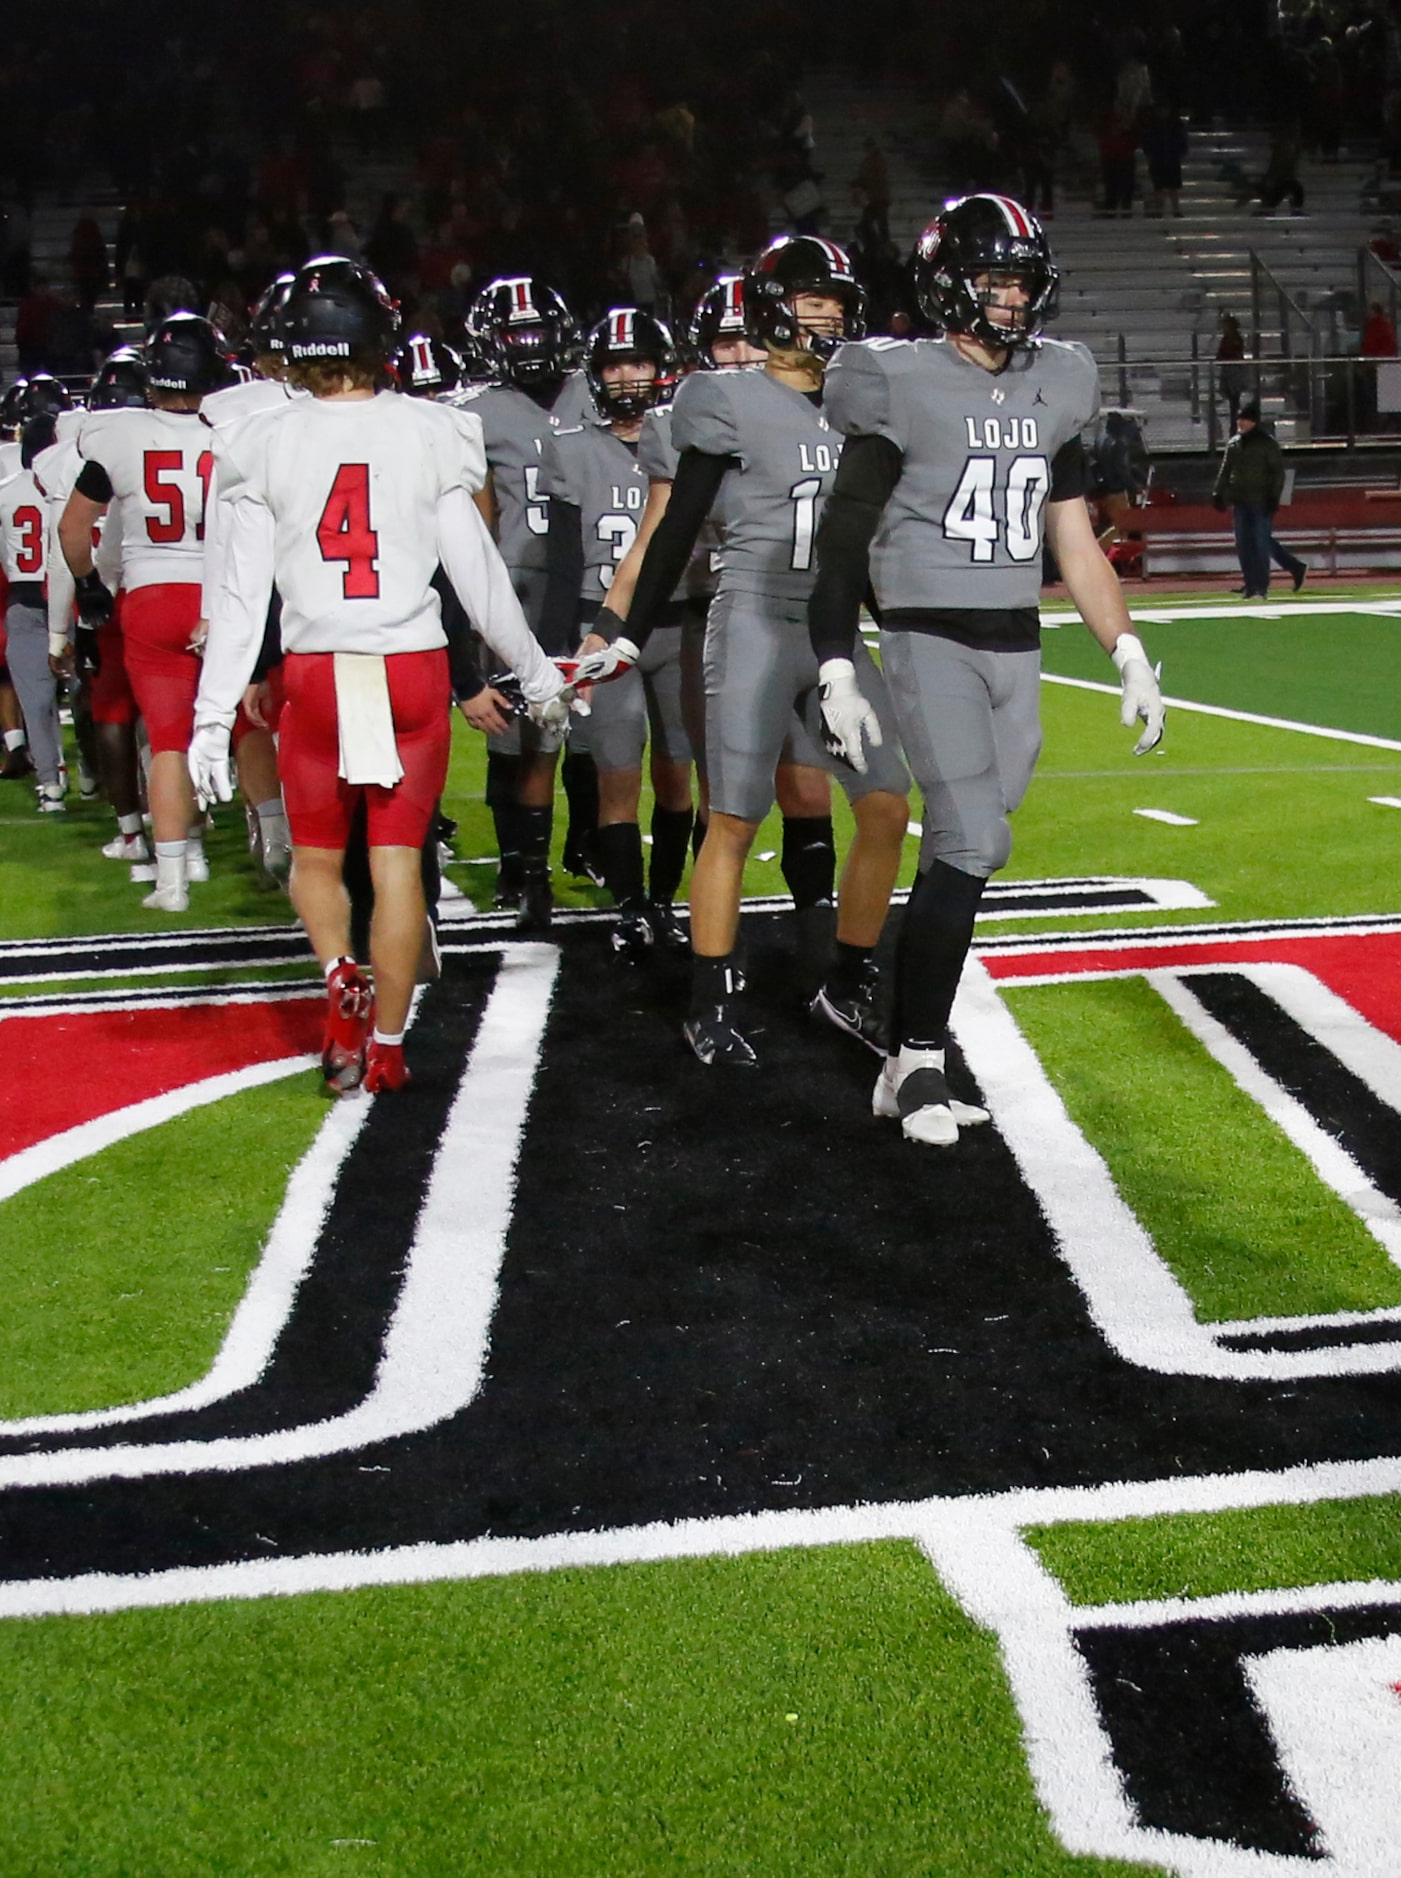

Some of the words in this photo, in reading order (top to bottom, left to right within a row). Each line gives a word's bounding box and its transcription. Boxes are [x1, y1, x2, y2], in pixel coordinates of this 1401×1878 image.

[292, 342, 350, 358] Riddell
[150, 377, 187, 390] Riddell
[965, 416, 1039, 449] LOJO
[315, 463, 380, 600] 4
[942, 454, 1050, 563] 40
[13, 505, 43, 574] 3
